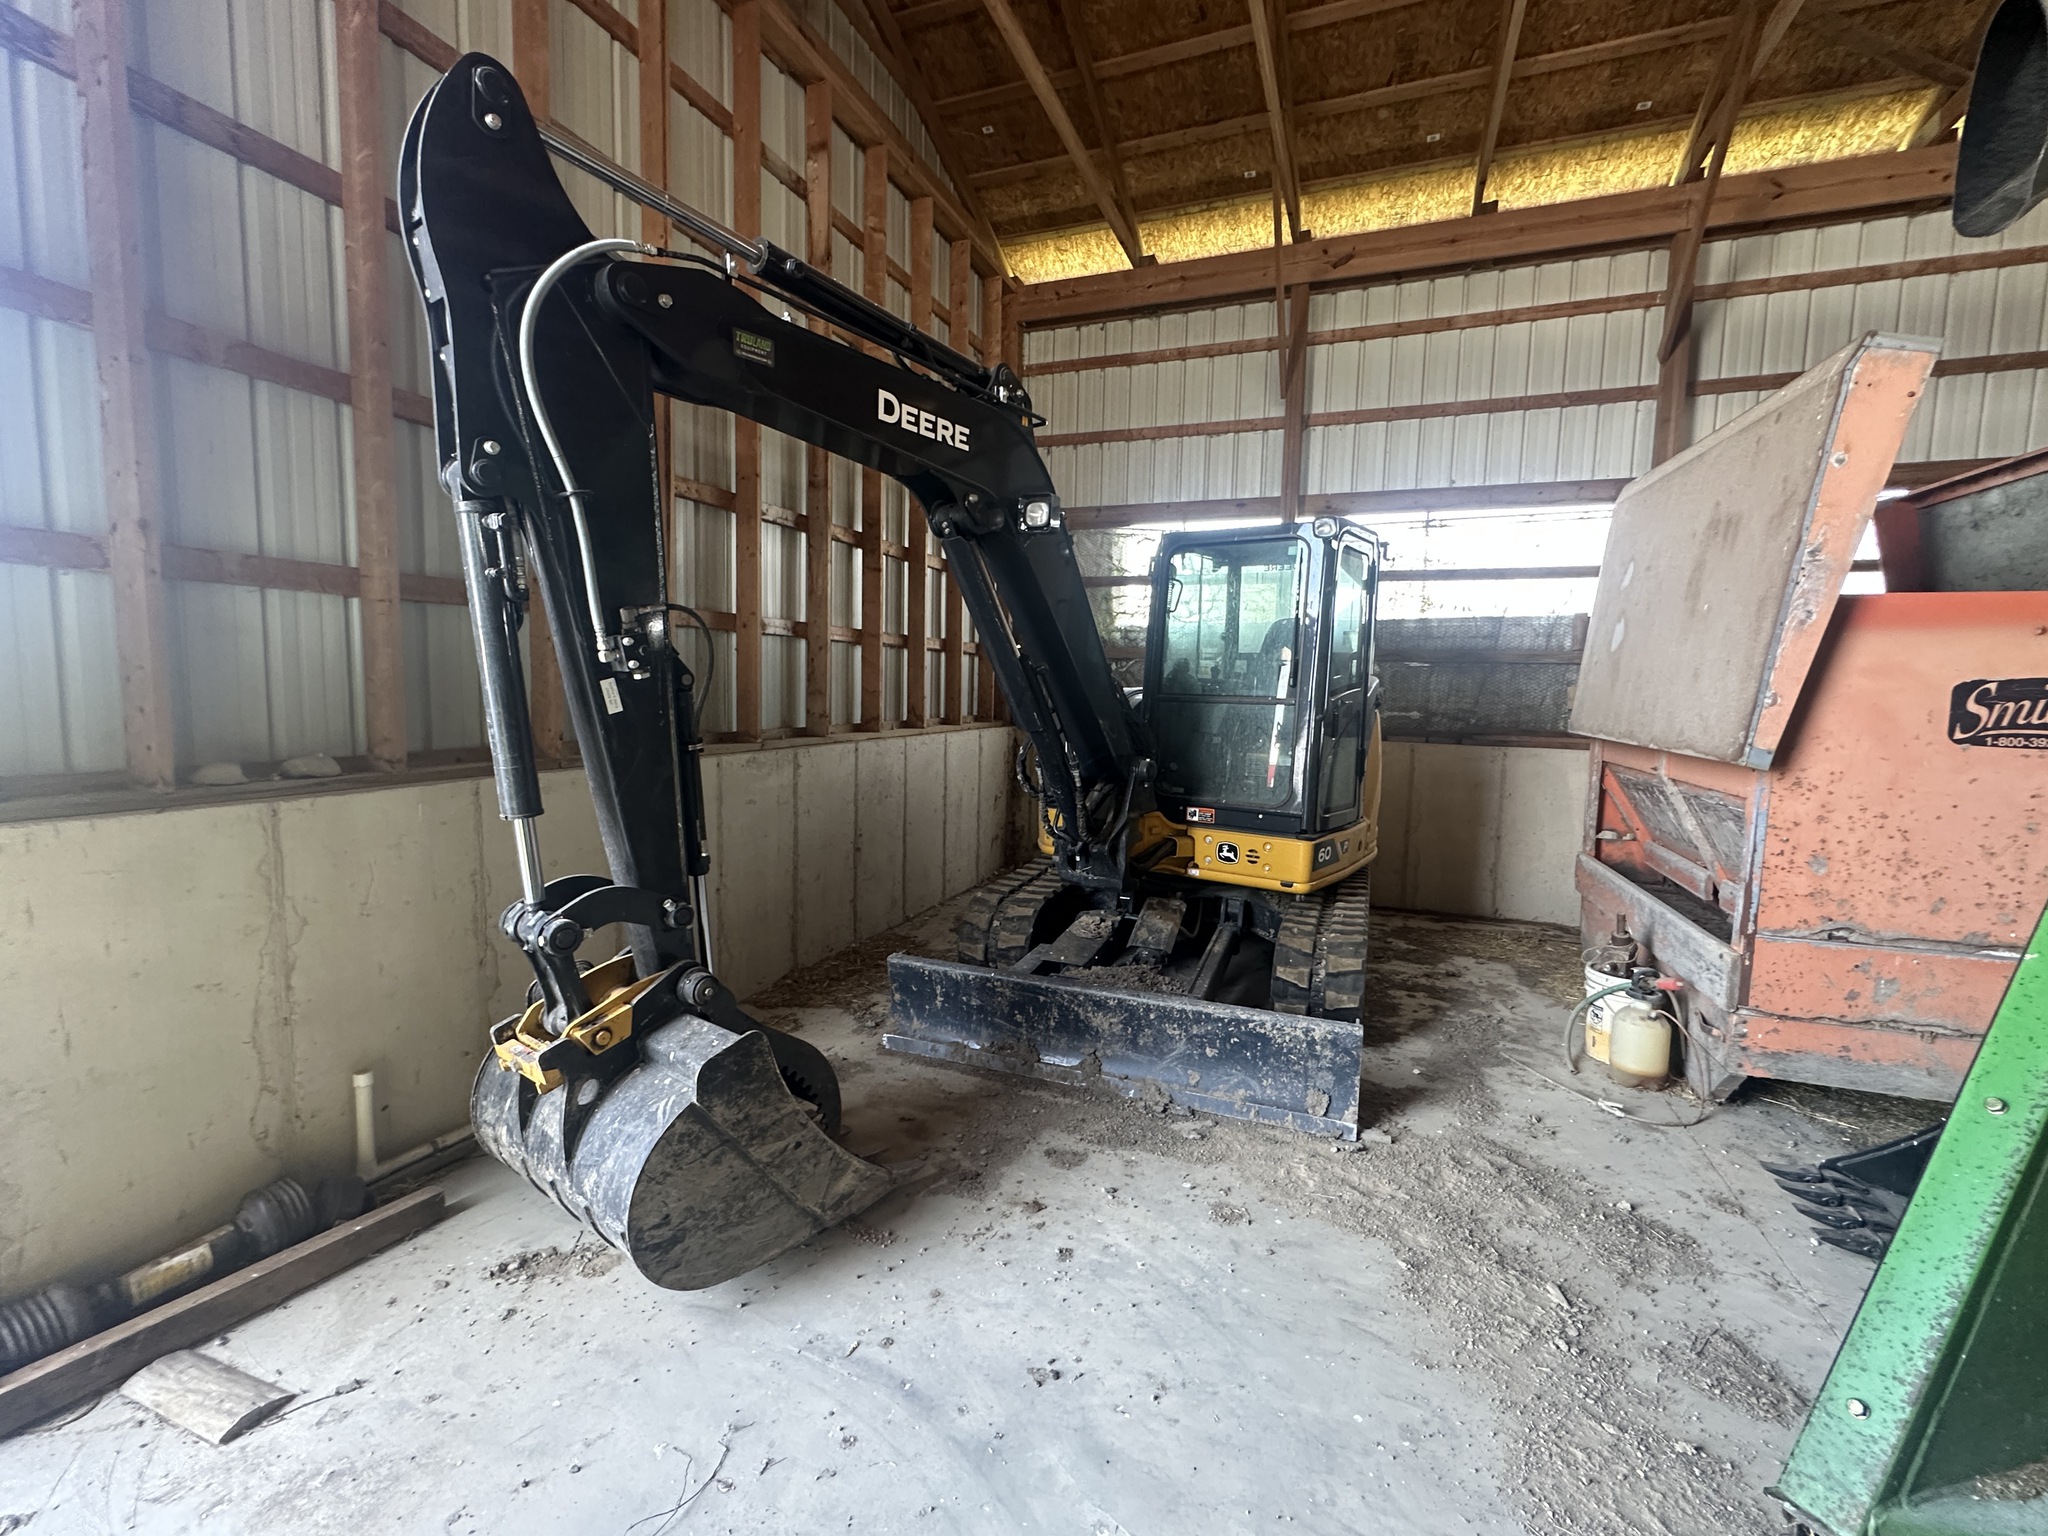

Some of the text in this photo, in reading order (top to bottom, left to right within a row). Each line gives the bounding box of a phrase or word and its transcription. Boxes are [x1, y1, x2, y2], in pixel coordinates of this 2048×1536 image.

[877, 388, 970, 451] DEERE
[1985, 737, 2048, 748] 1-800-39
[1317, 845, 1332, 863] 60
